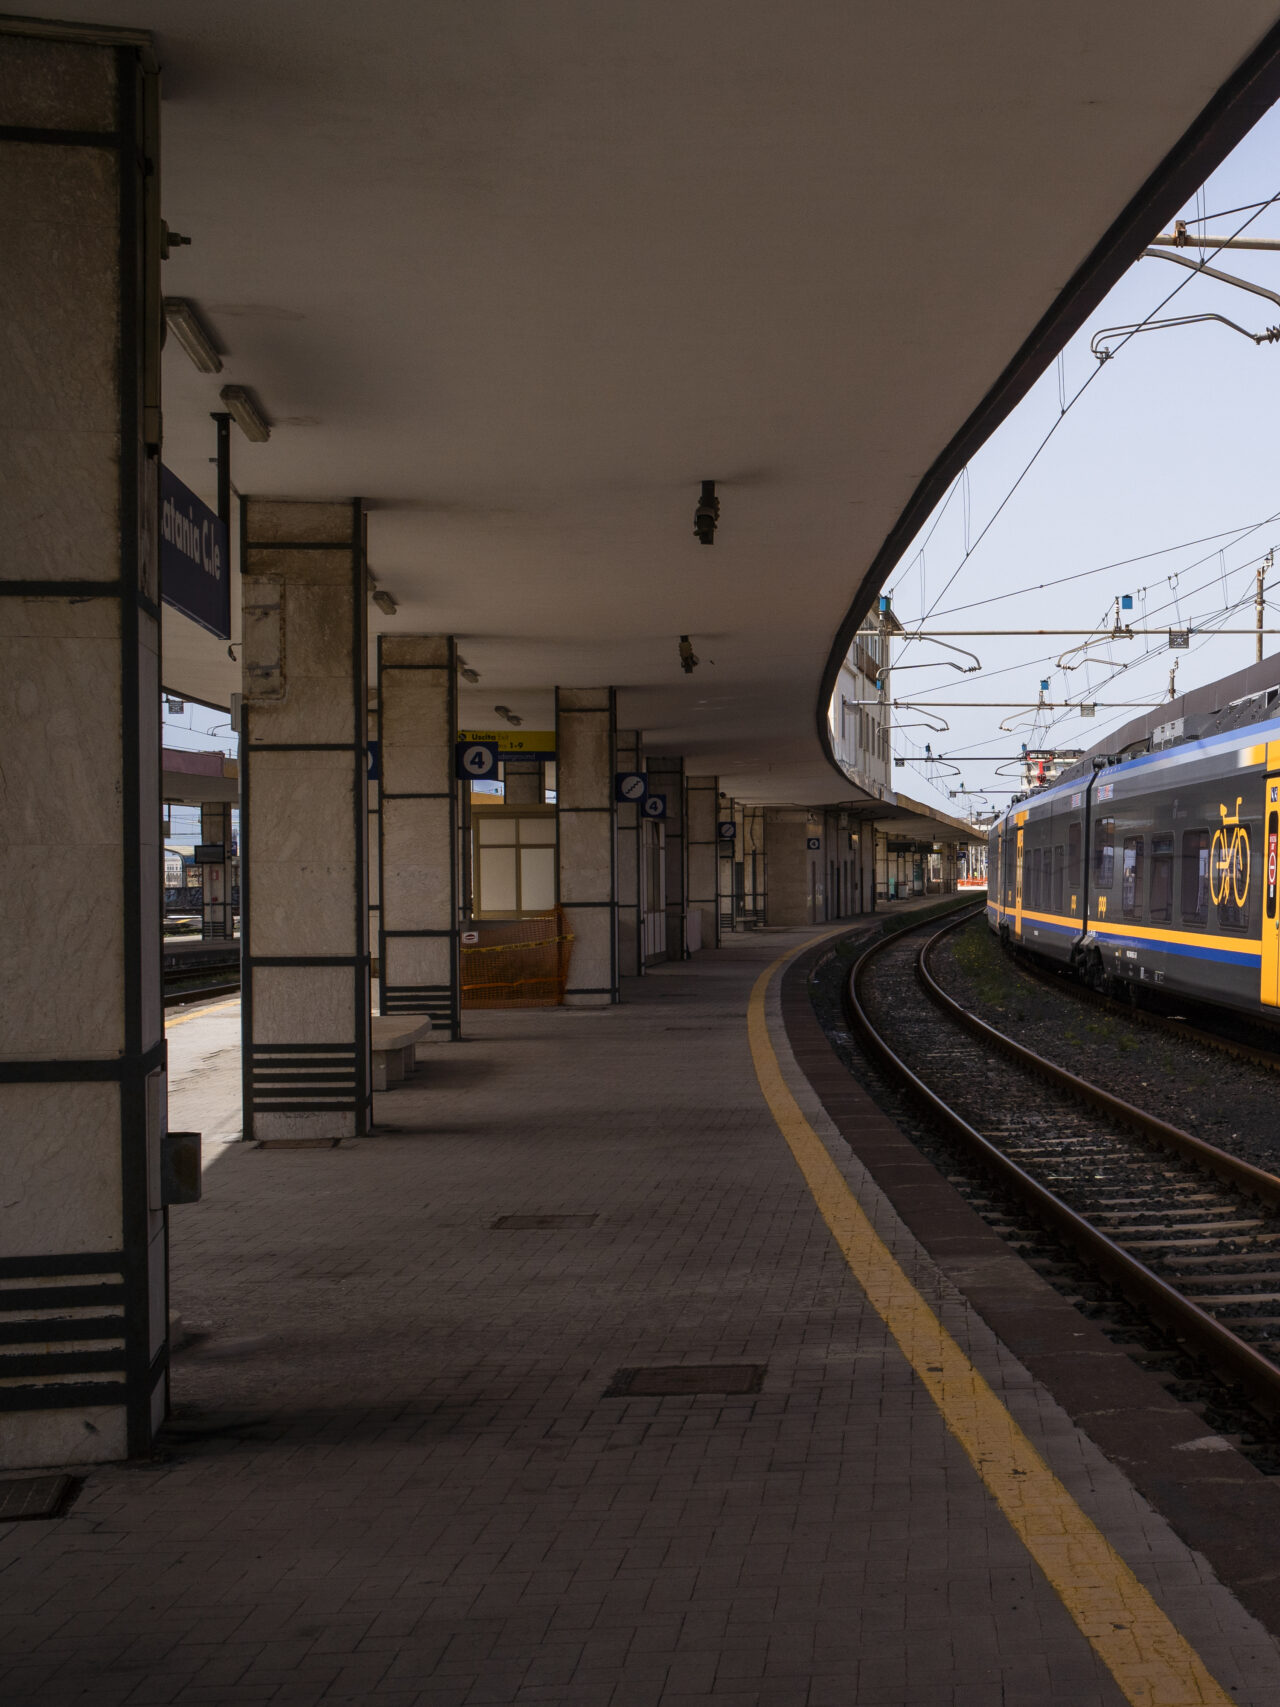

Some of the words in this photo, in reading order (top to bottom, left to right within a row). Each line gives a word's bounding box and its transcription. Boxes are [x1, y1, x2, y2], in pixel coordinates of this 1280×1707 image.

[161, 496, 201, 565] atania
[202, 519, 221, 581] C.le
[469, 751, 486, 769] 4
[649, 800, 659, 812] 4
